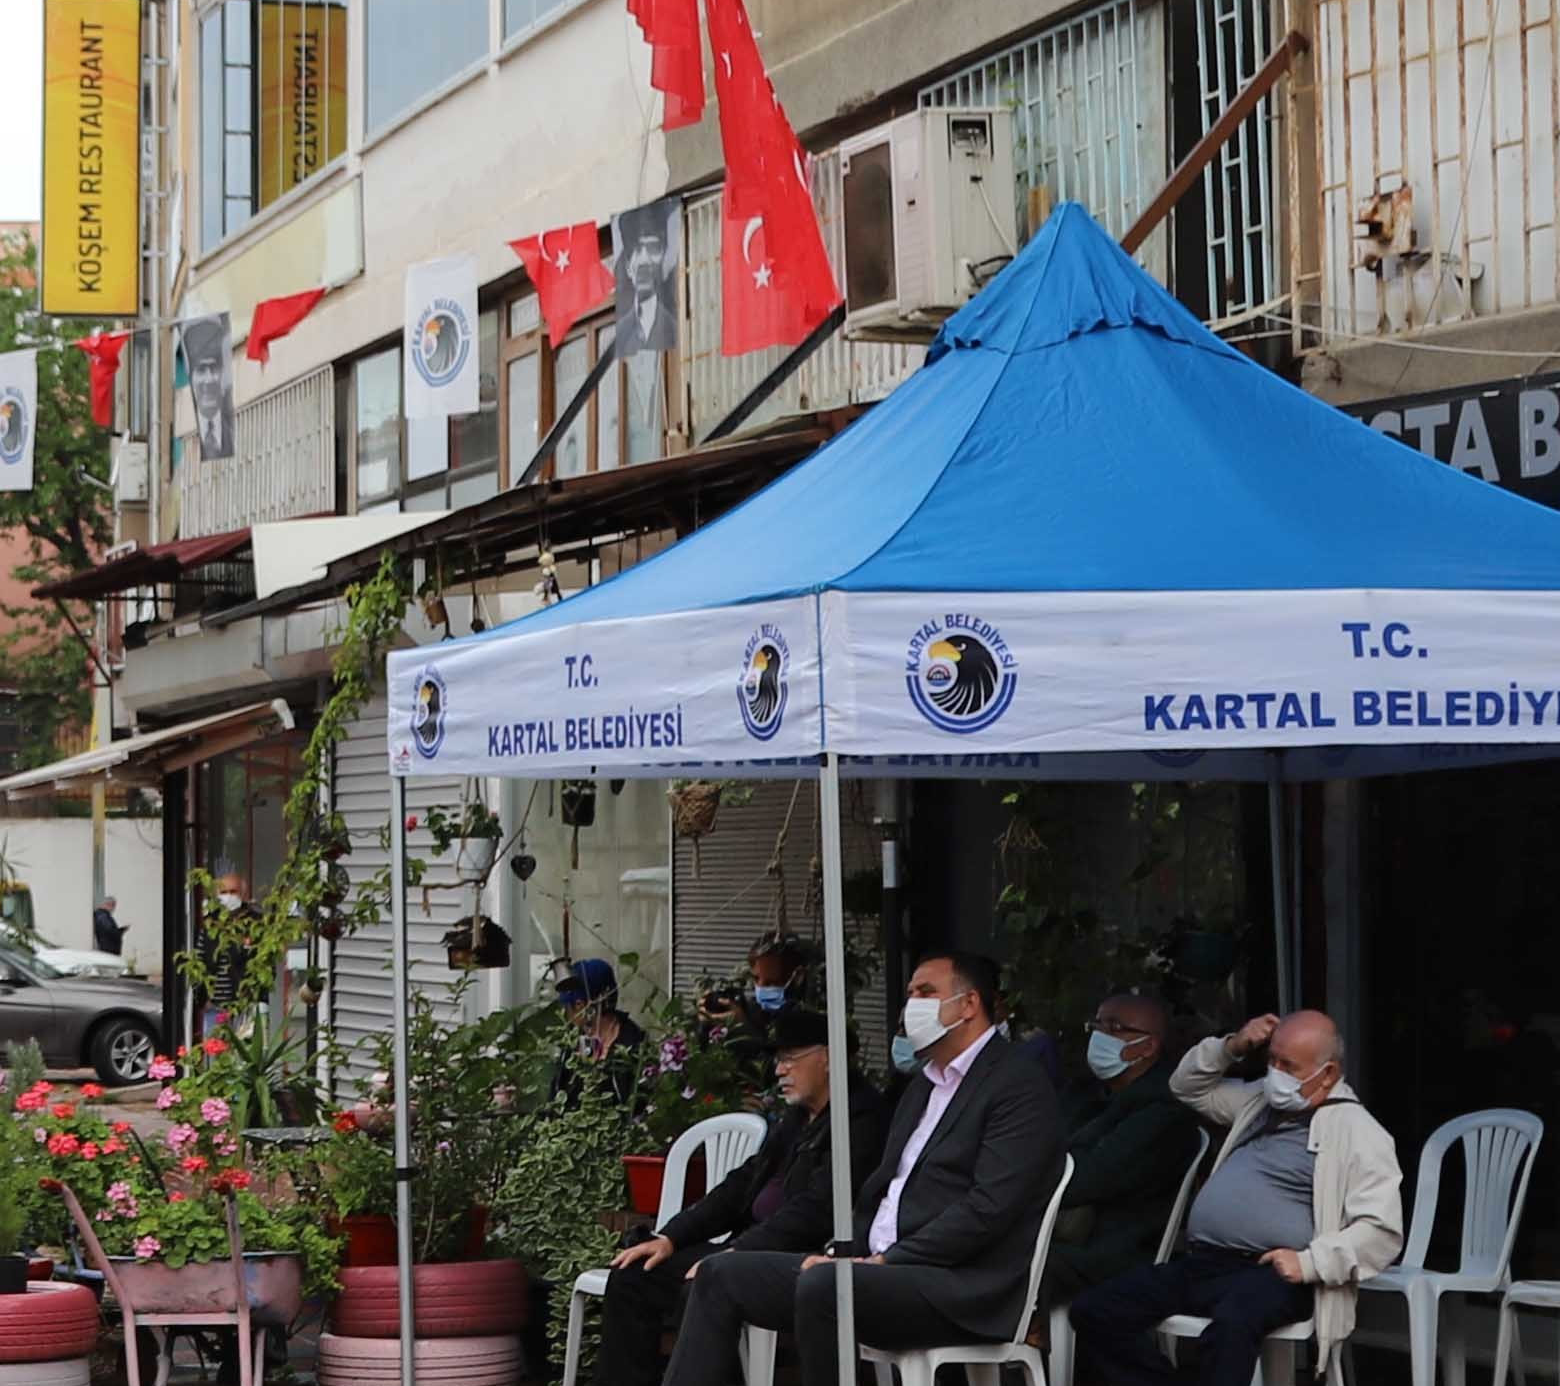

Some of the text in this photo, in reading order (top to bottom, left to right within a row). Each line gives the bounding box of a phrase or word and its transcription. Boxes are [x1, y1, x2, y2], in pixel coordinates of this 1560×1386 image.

[73, 18, 108, 293] KÖŞEM RESTAURANT
[906, 613, 1019, 671] KARTAL BELEDİYESİ
[1342, 622, 1428, 658] T.C.
[565, 654, 598, 688] T.C.
[488, 704, 683, 757] KARTAL BELEDİYESİ
[1143, 691, 1336, 730] KARTAL
